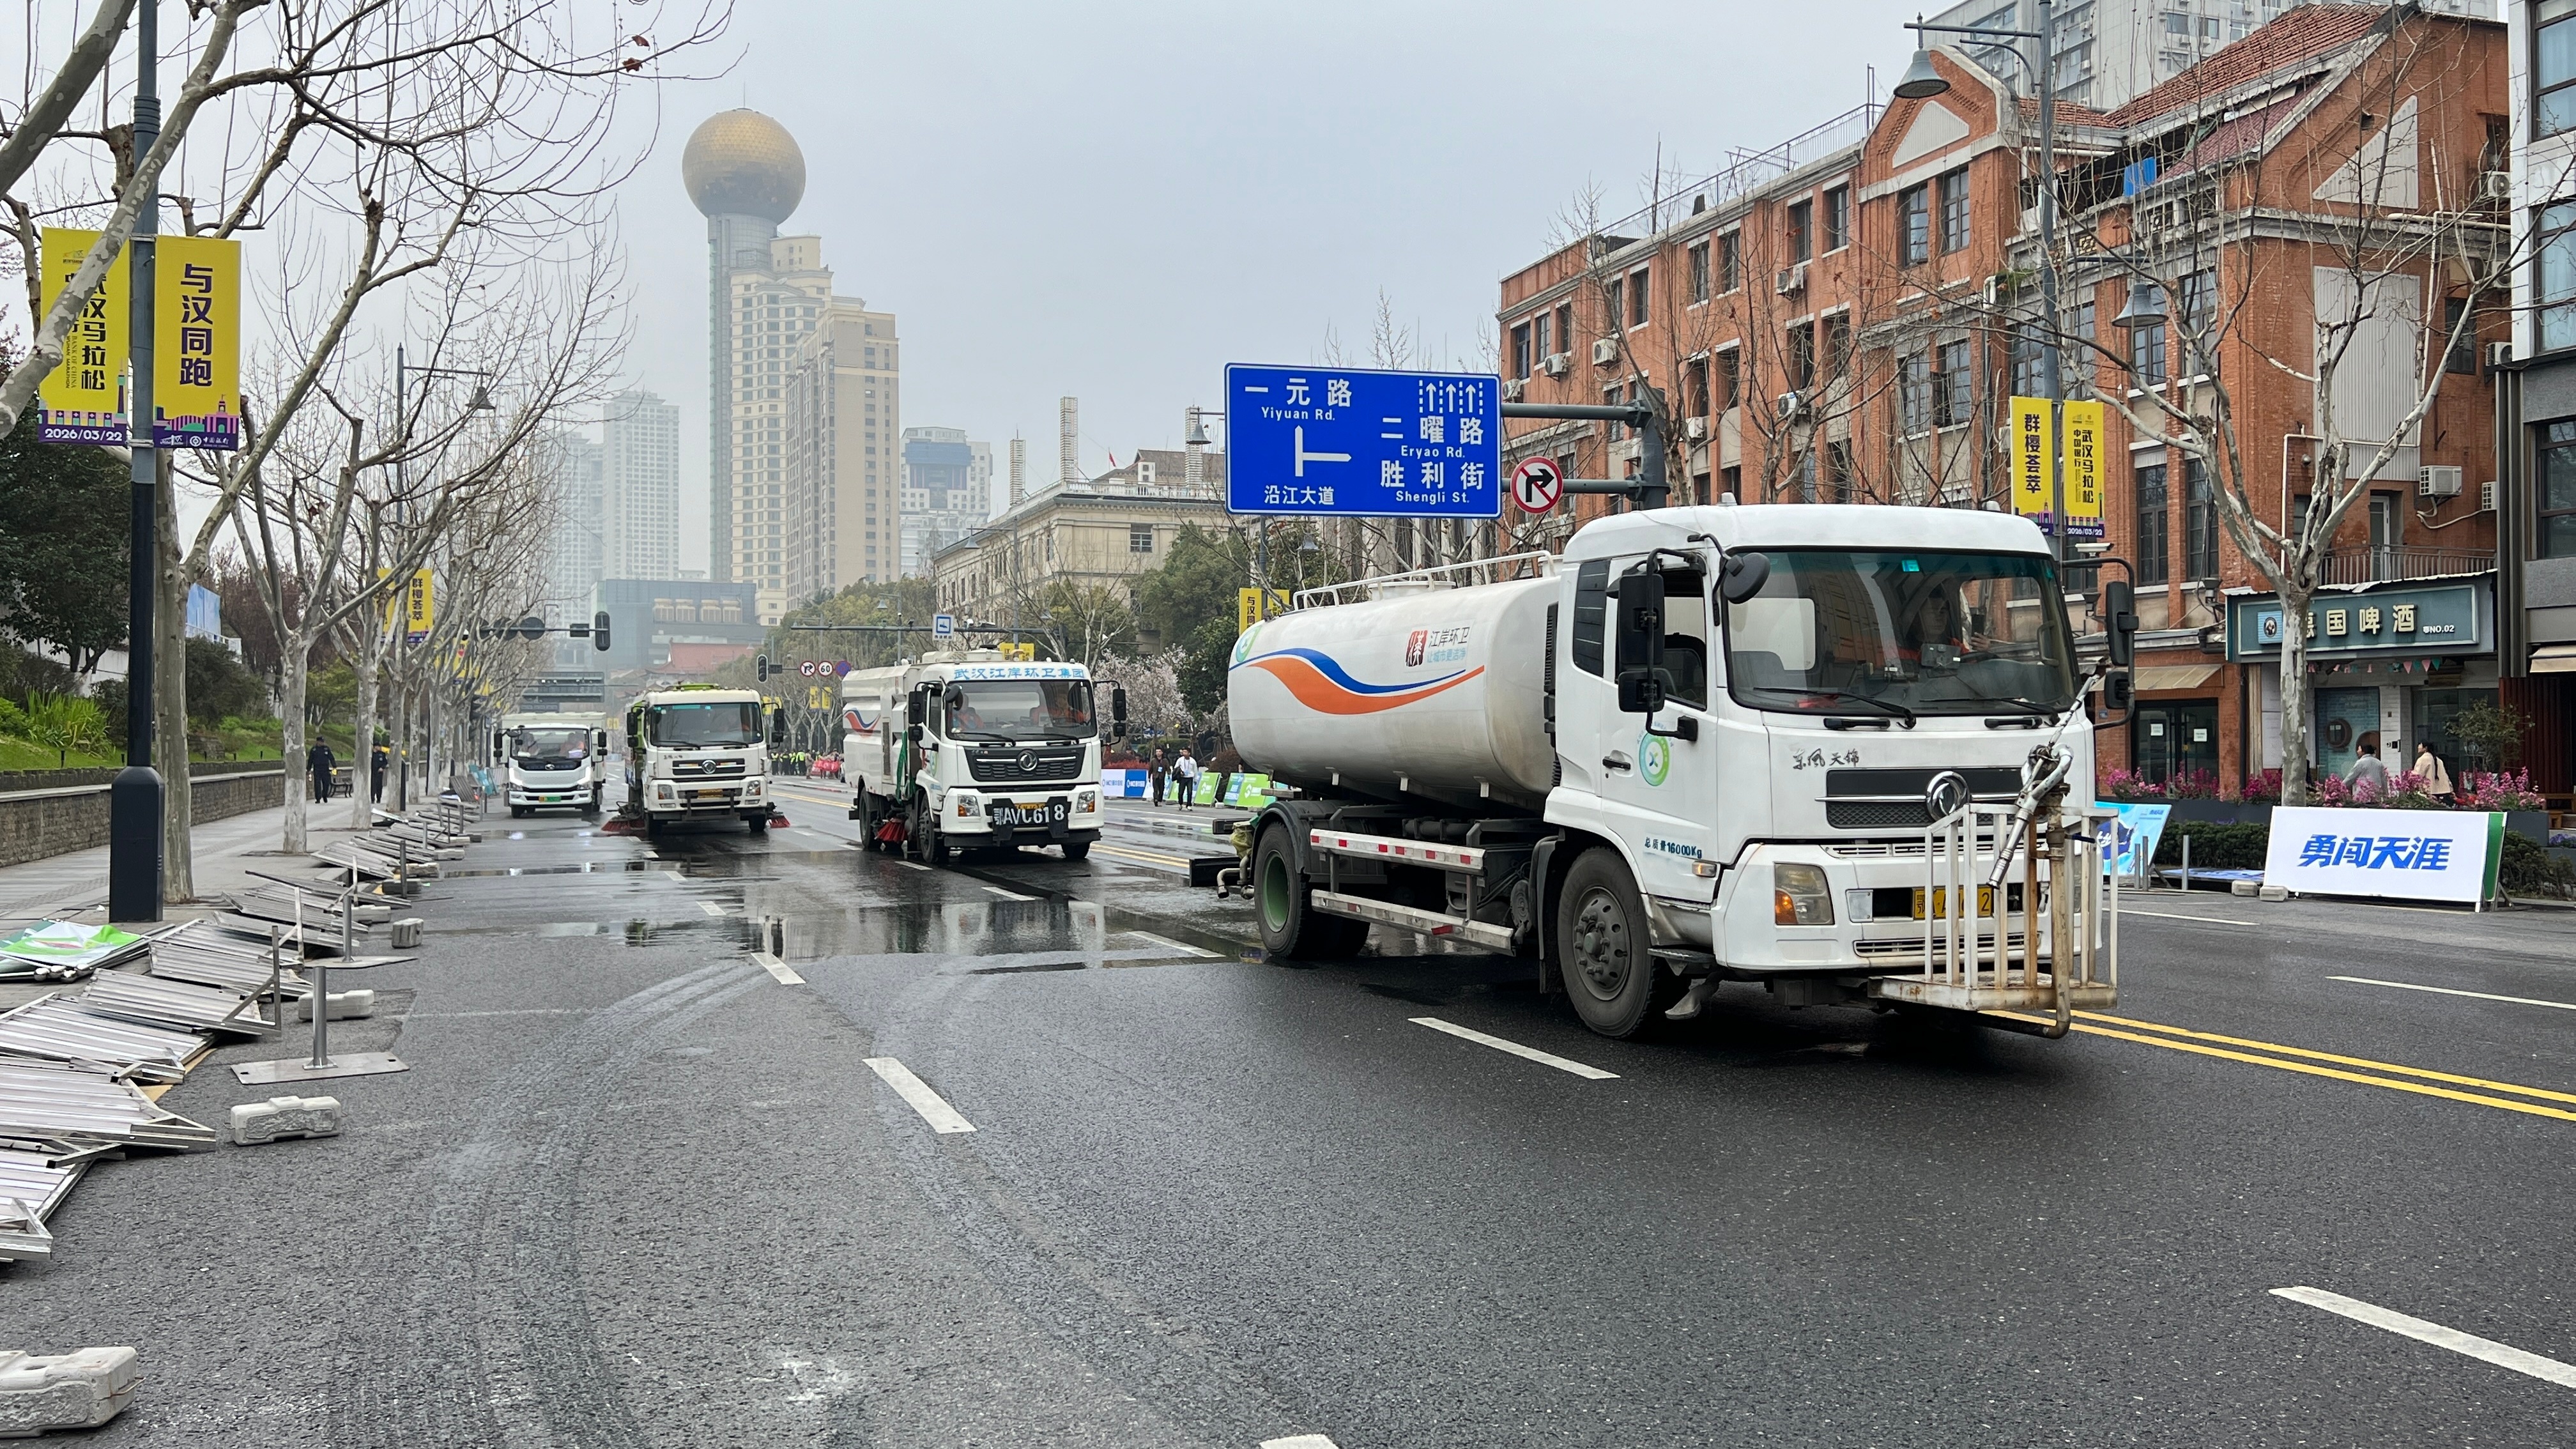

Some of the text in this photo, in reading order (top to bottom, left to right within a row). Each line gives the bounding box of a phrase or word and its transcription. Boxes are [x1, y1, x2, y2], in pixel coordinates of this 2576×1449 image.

[180, 263, 213, 387] 与汉同跑
[71, 354, 77, 363] OF
[1245, 377, 1352, 408] 一元路
[1261, 406, 1335, 421] Yiyuan Rd.
[45, 428, 122, 441] 2026/03/22
[1381, 415, 1484, 445] 二曜路
[1401, 445, 1466, 459] Eryao Rd.
[2024, 413, 2041, 494] 群樱荟萃
[2073, 429, 2082, 467] 中国银行
[1380, 460, 1485, 490] 胜利街
[2082, 429, 2094, 503] 武汉马拉松
[1264, 485, 1335, 505] 沿江大道
[1395, 490, 1469, 505] Shengli St.
[1247, 596, 1255, 629] 与汉同
[1429, 627, 1470, 648] 江岸环卫
[954, 667, 1085, 680] 武汉江岸环卫集团
[2297, 834, 2453, 871] 勇闯天涯
